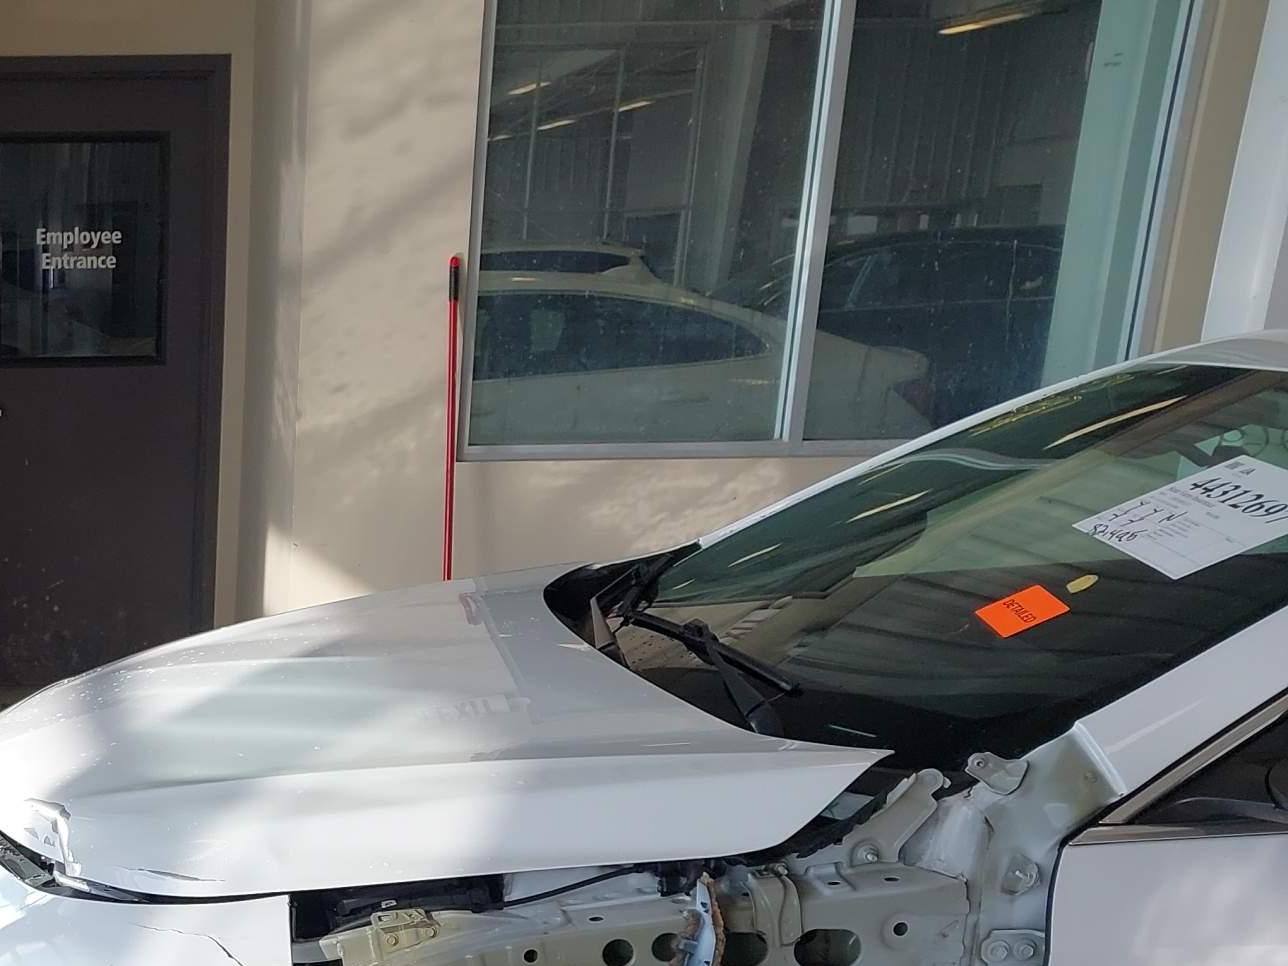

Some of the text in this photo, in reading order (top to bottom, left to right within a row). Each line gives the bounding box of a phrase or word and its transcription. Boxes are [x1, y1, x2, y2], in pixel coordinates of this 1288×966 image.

[36, 227, 122, 249] Employee
[41, 253, 117, 270] Entrance
[1002, 599, 1037, 623] DETAILED
